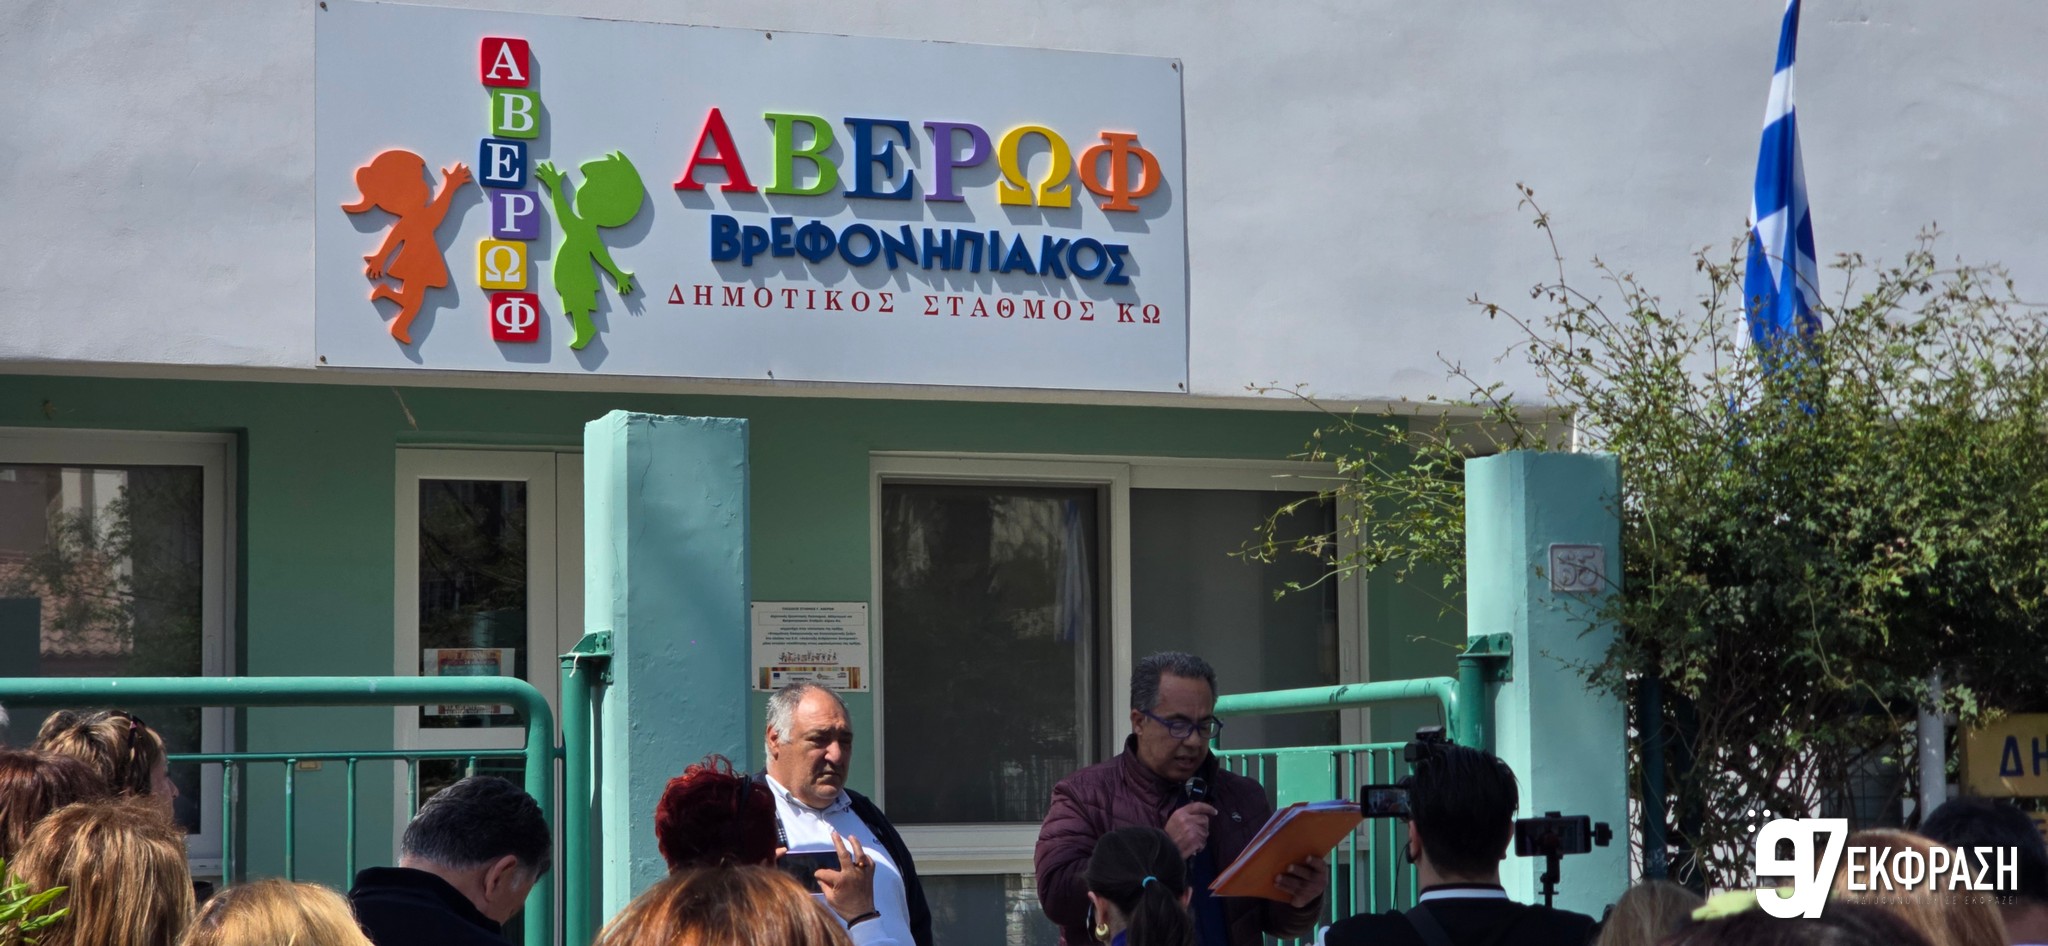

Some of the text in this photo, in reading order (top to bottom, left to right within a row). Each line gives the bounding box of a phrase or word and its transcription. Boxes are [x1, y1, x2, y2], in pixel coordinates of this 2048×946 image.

[673, 107, 1162, 212] ΑΒΕΡΩΦ
[667, 283, 1162, 324] ΔΗΜΟΤΙΚΟΣ ΣΤΑΘΜΟΣ ΚΩ
